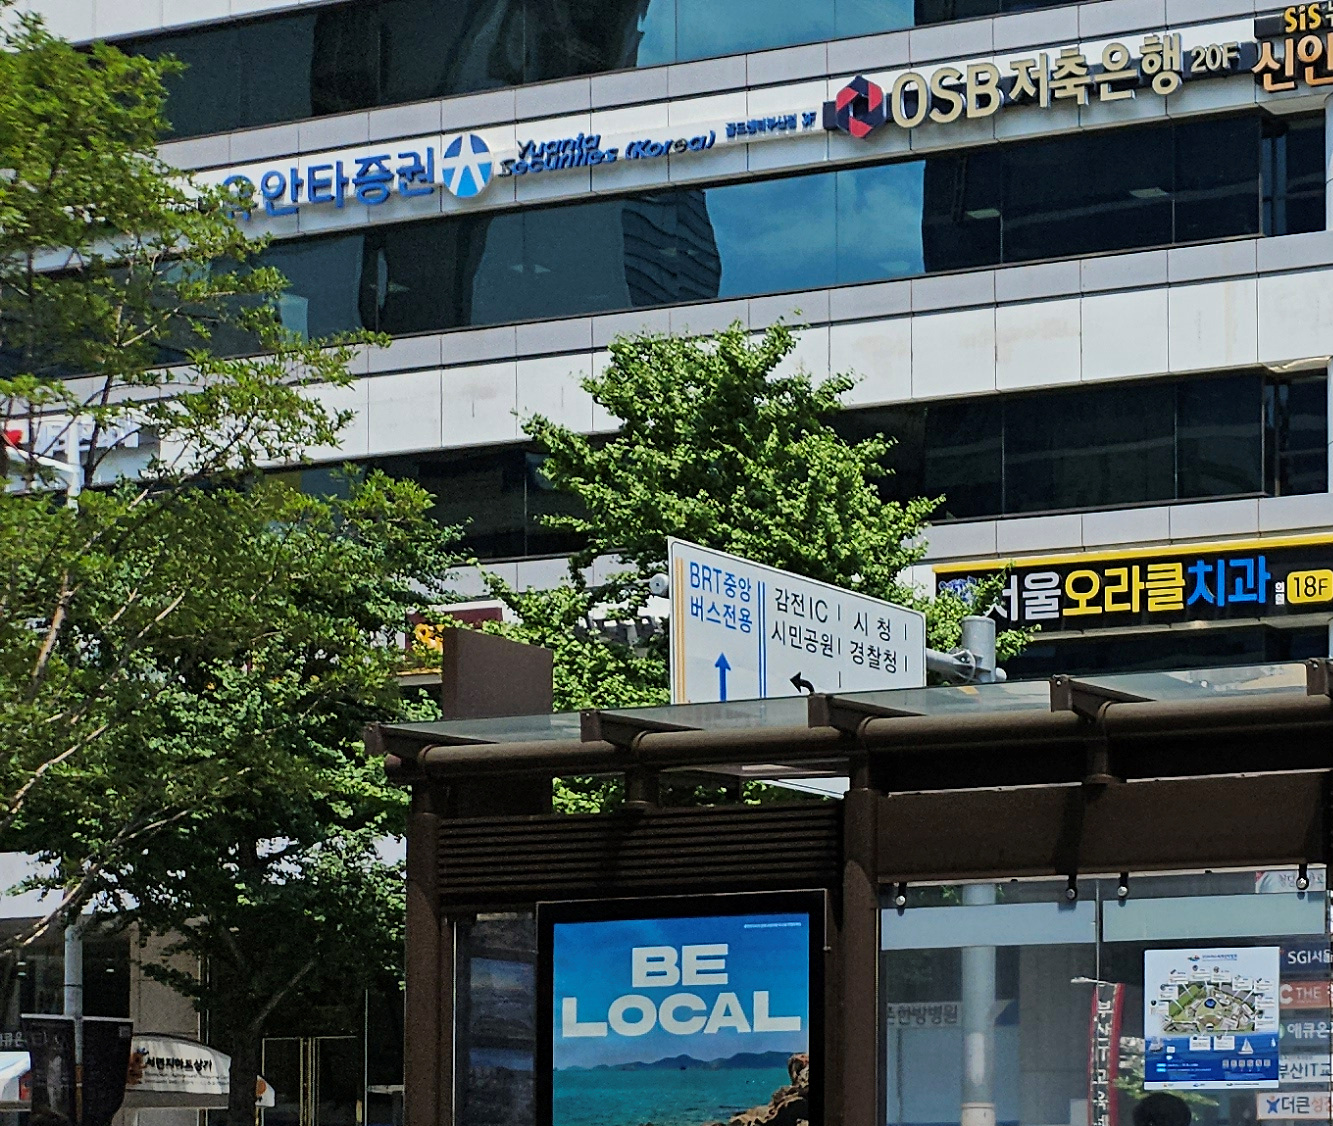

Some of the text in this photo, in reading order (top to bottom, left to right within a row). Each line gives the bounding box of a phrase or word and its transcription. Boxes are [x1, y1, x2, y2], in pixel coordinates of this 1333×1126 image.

[1190, 42, 1240, 74] 20F
[624, 130, 717, 161] (Korea)
[689, 561, 752, 603] BRT중앙
[1292, 574, 1329, 599] 18F
[690, 596, 753, 634] 버스전용
[774, 586, 828, 624] 감전IC
[771, 620, 897, 675] 시민공원 경찰청
[632, 943, 729, 988] BE
[562, 990, 801, 1038] LOCAL
